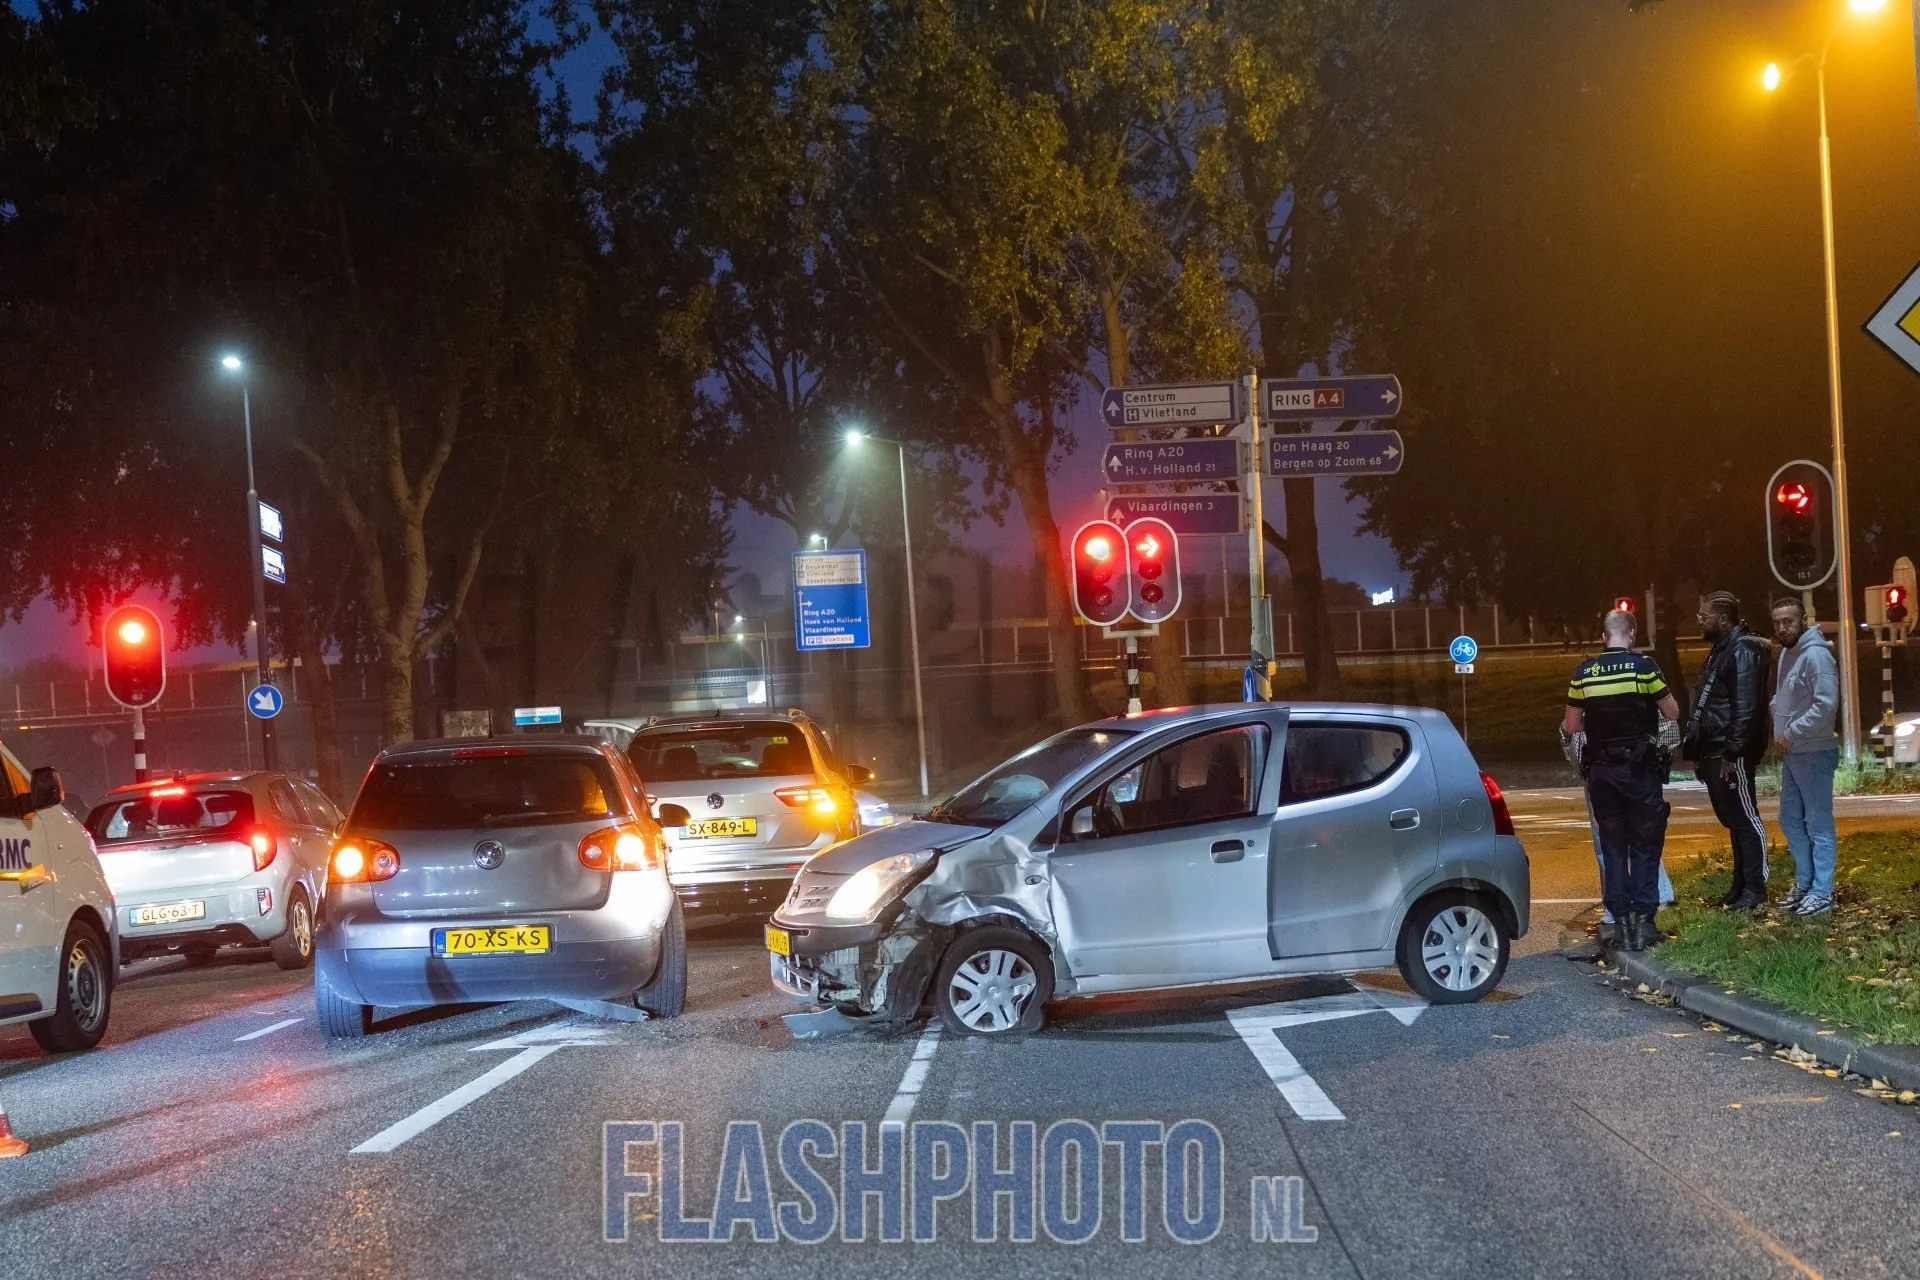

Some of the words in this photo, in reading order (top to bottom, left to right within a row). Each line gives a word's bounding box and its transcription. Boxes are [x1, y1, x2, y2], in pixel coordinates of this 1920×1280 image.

[1125, 393, 1176, 403] Centrum
[1275, 394, 1311, 406] RING
[1317, 392, 1340, 405] A4
[1143, 406, 1197, 418] Vlietland
[1125, 449, 1153, 461] Ring
[1158, 446, 1184, 458] A20
[1273, 442, 1296, 452] Den
[1301, 441, 1332, 453] Haag
[1336, 441, 1350, 451] 20
[1153, 462, 1201, 474] Holland
[1205, 463, 1216, 472] 21
[1274, 458, 1314, 471] Bergen
[1318, 460, 1331, 471] op
[1335, 456, 1366, 467] Zoom
[1369, 457, 1382, 465] 68
[1128, 501, 1203, 514] Vlaardingen
[1207, 502, 1214, 511] 3
[805, 626, 845, 634] Vlaardingen
[1586, 662, 1630, 676] POLITIE
[689, 821, 750, 835] SX-849-L
[142, 904, 199, 921] GLG-63-T
[452, 929, 541, 950] 70-XS-KS
